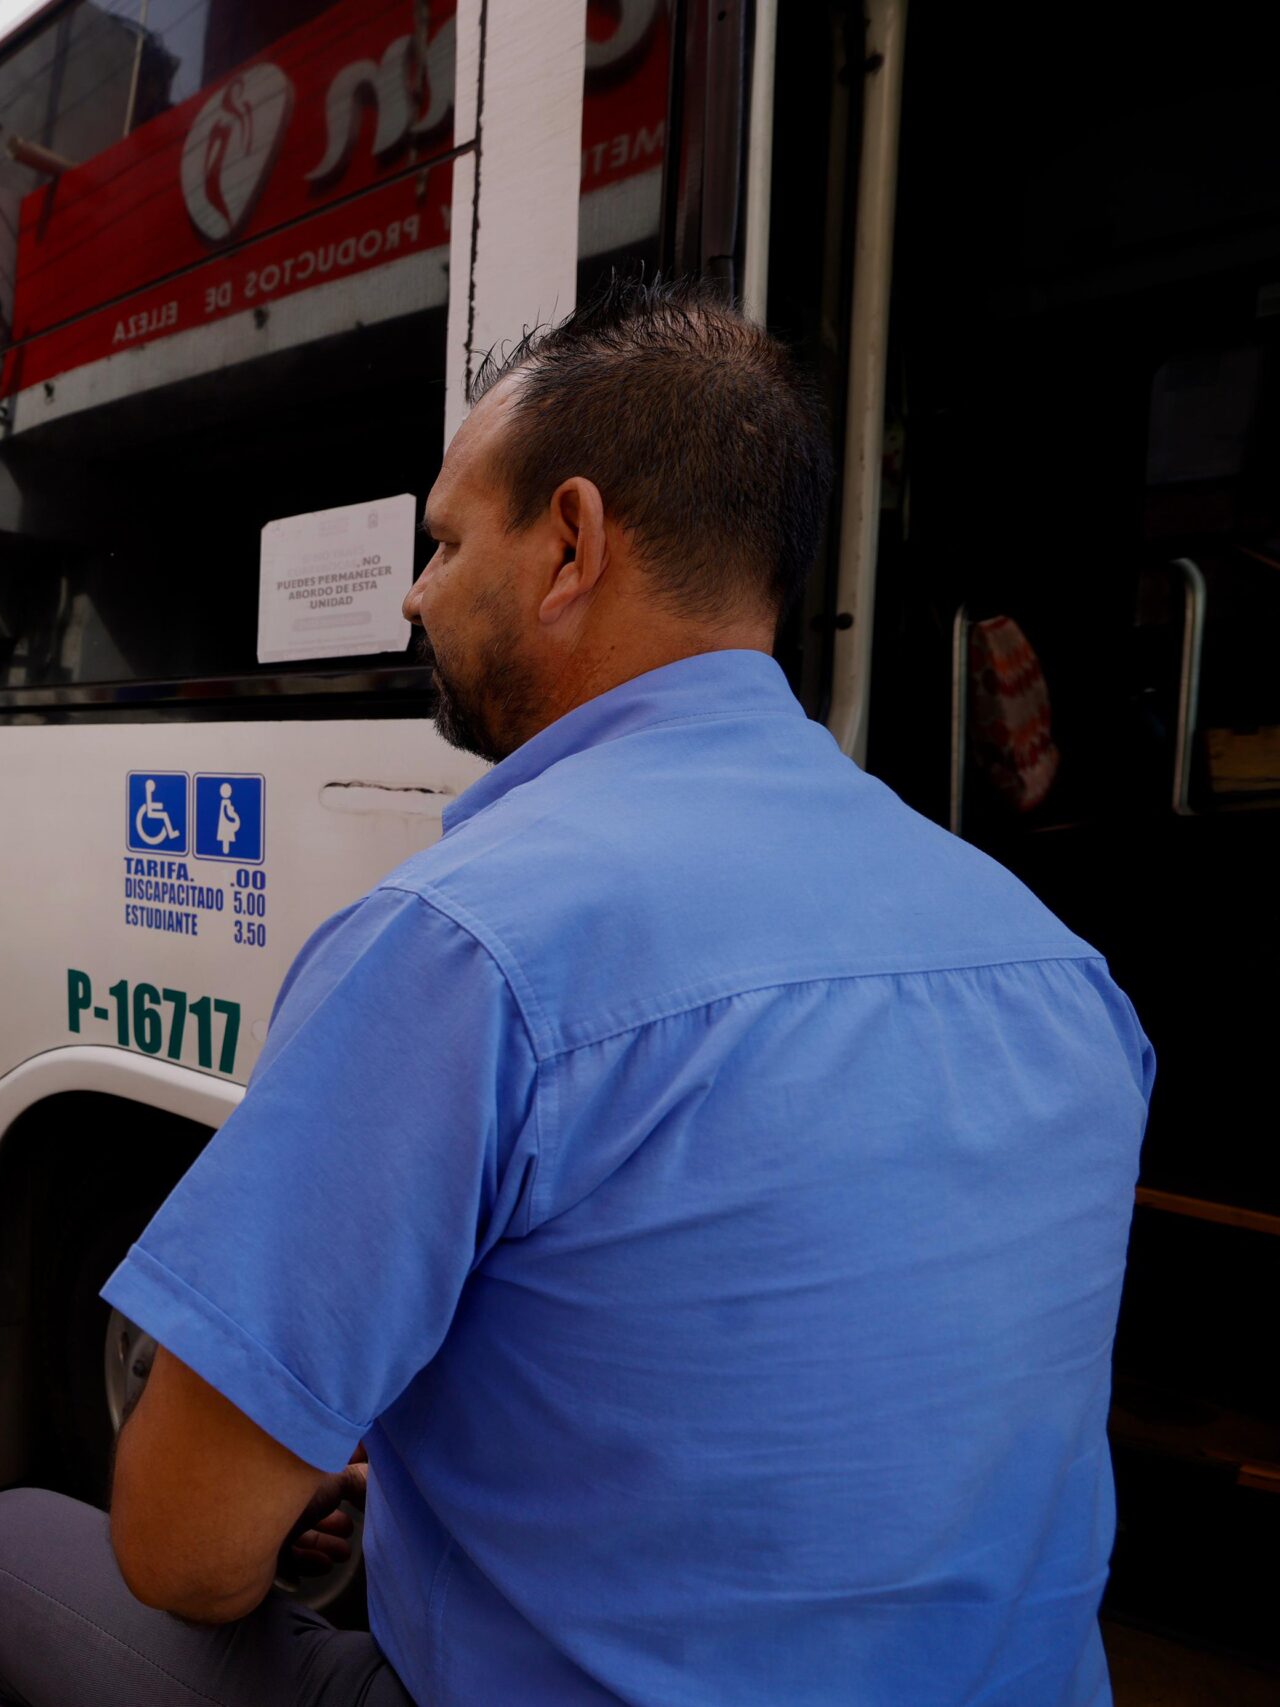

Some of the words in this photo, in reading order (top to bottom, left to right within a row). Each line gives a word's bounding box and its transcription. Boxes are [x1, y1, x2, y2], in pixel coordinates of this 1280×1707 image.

[362, 554, 381, 567] NO
[276, 576, 317, 592] PUEDES
[317, 565, 393, 586] PERMANECER
[288, 585, 334, 601] ABORDO
[335, 584, 350, 596] DE
[352, 579, 378, 593] ESTA
[309, 595, 354, 610] UNIDAD
[124, 857, 195, 882] TARIFA.
[230, 868, 266, 890] .00
[125, 877, 224, 912] DISCAPACITADO
[233, 890, 266, 918] 5.00
[125, 904, 199, 936] ESTUDIANTE
[234, 919, 266, 948] 3.50
[67, 968, 242, 1075] P-16717
